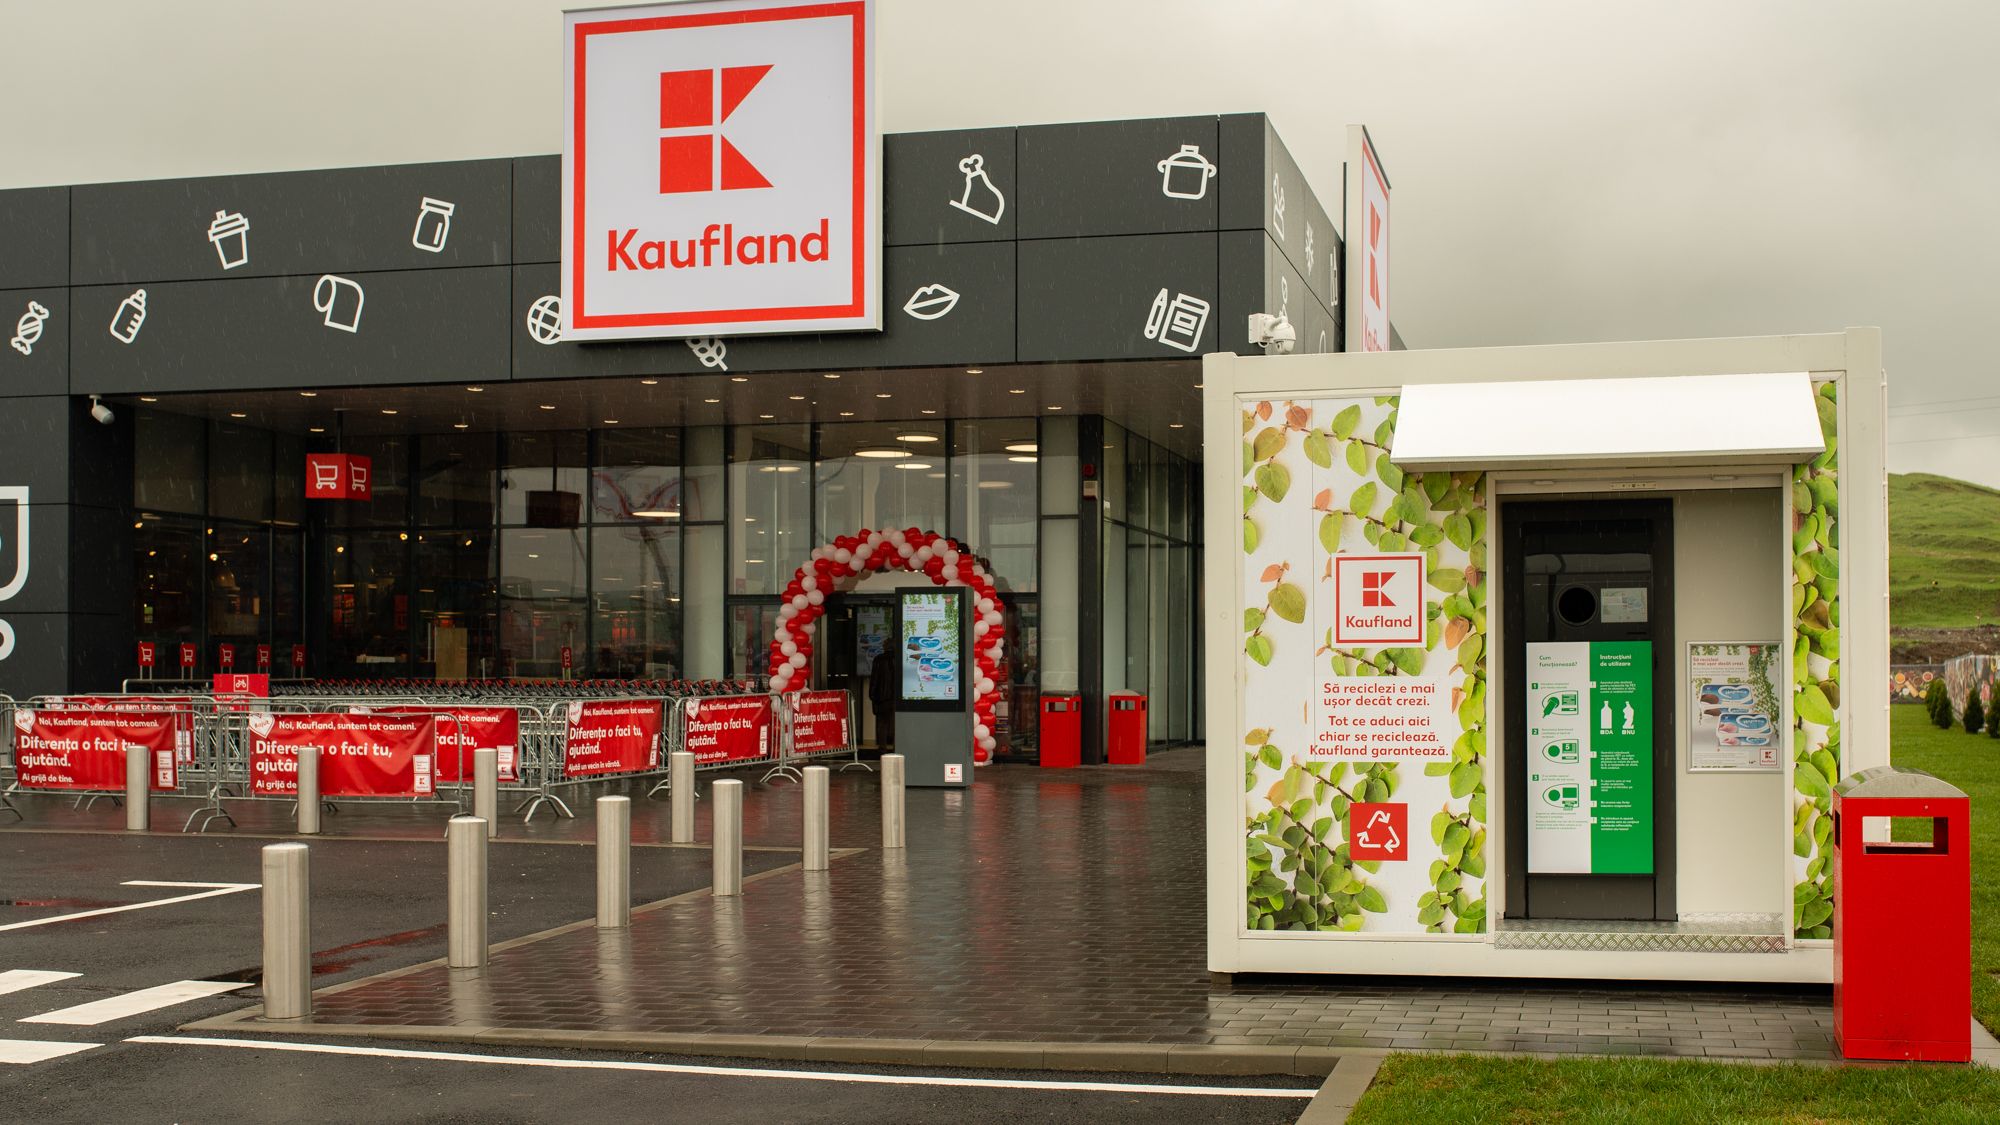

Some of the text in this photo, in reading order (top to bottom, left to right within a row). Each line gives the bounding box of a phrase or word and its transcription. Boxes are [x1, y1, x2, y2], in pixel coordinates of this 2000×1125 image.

[608, 218, 829, 272] Kaufland
[1346, 615, 1412, 628] Kaufland
[1324, 682, 1435, 694] Să reciclezi e mai
[1324, 696, 1430, 709] ușor decât crezi.
[38, 718, 53, 726] Noi,
[53, 718, 88, 727] Kaufland,
[90, 718, 116, 727] suntem
[116, 720, 128, 728] tot
[130, 720, 160, 728] oameni.
[470, 714, 500, 722] oameni.
[1328, 715, 1430, 726] Tot ce aduci aici
[278, 721, 294, 730] Noi,
[296, 721, 336, 731] Kaufland,
[337, 722, 368, 730] suntem
[368, 722, 381, 731] tot
[382, 722, 417, 731] oameni.
[688, 720, 722, 734] Diferența
[730, 718, 741, 728] faci
[742, 718, 752, 729] tu,
[570, 724, 642, 742] Diferența o faci tu,
[1320, 730, 1439, 742] chiar se reciclează.
[21, 736, 78, 754] Diferența
[82, 740, 90, 750] o
[94, 737, 118, 751] faci
[461, 734, 478, 748] tu,
[688, 734, 718, 749] ajutând.
[328, 746, 337, 756] o
[341, 741, 368, 756] faci
[372, 744, 392, 758] tu,
[569, 741, 602, 758] ajutând.
[1310, 744, 1448, 758] Kaufland garantează.
[21, 754, 72, 768] ajutând.
[22, 774, 74, 784] Ai grijă de tine.
[256, 780, 296, 790] Ai grijă de
